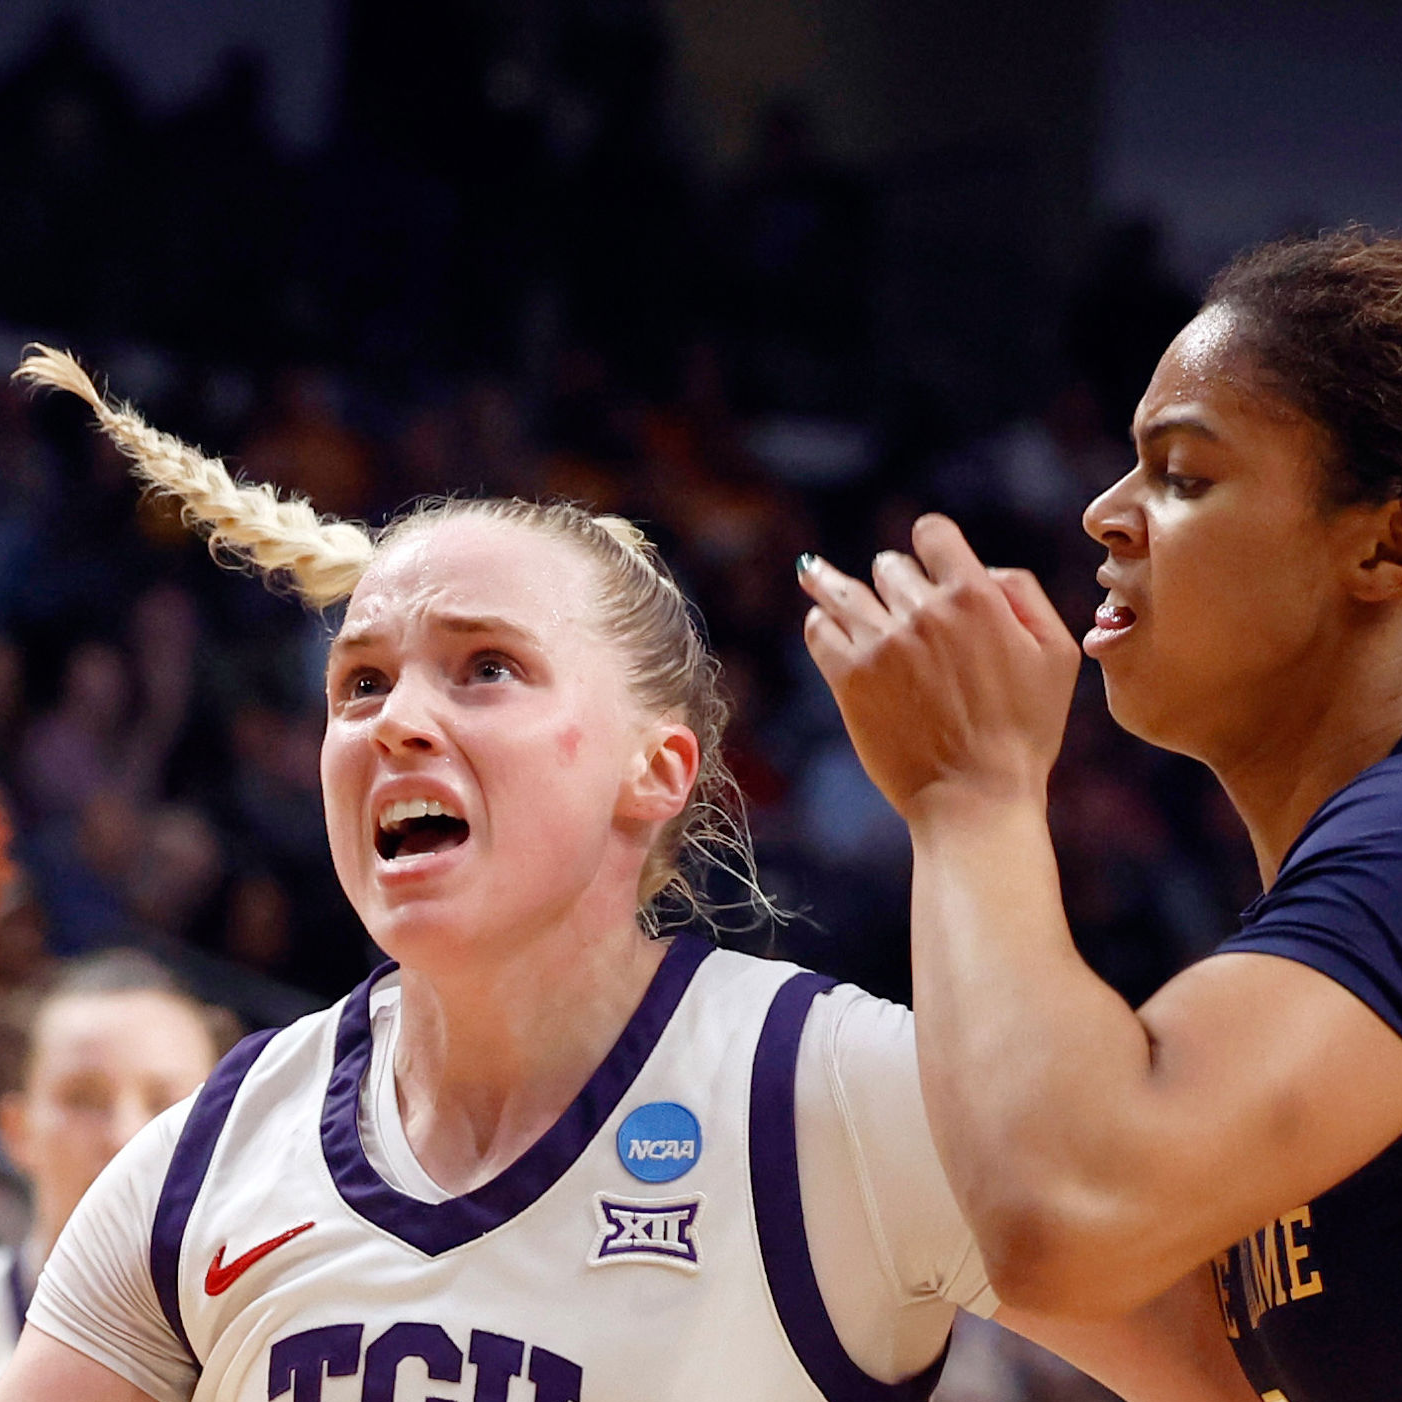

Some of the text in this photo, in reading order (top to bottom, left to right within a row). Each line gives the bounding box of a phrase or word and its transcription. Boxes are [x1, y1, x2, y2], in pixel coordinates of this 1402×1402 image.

[628, 1138, 696, 1161] NCAA
[606, 1208, 691, 1254] XII
[1238, 1205, 1323, 1330] ME
